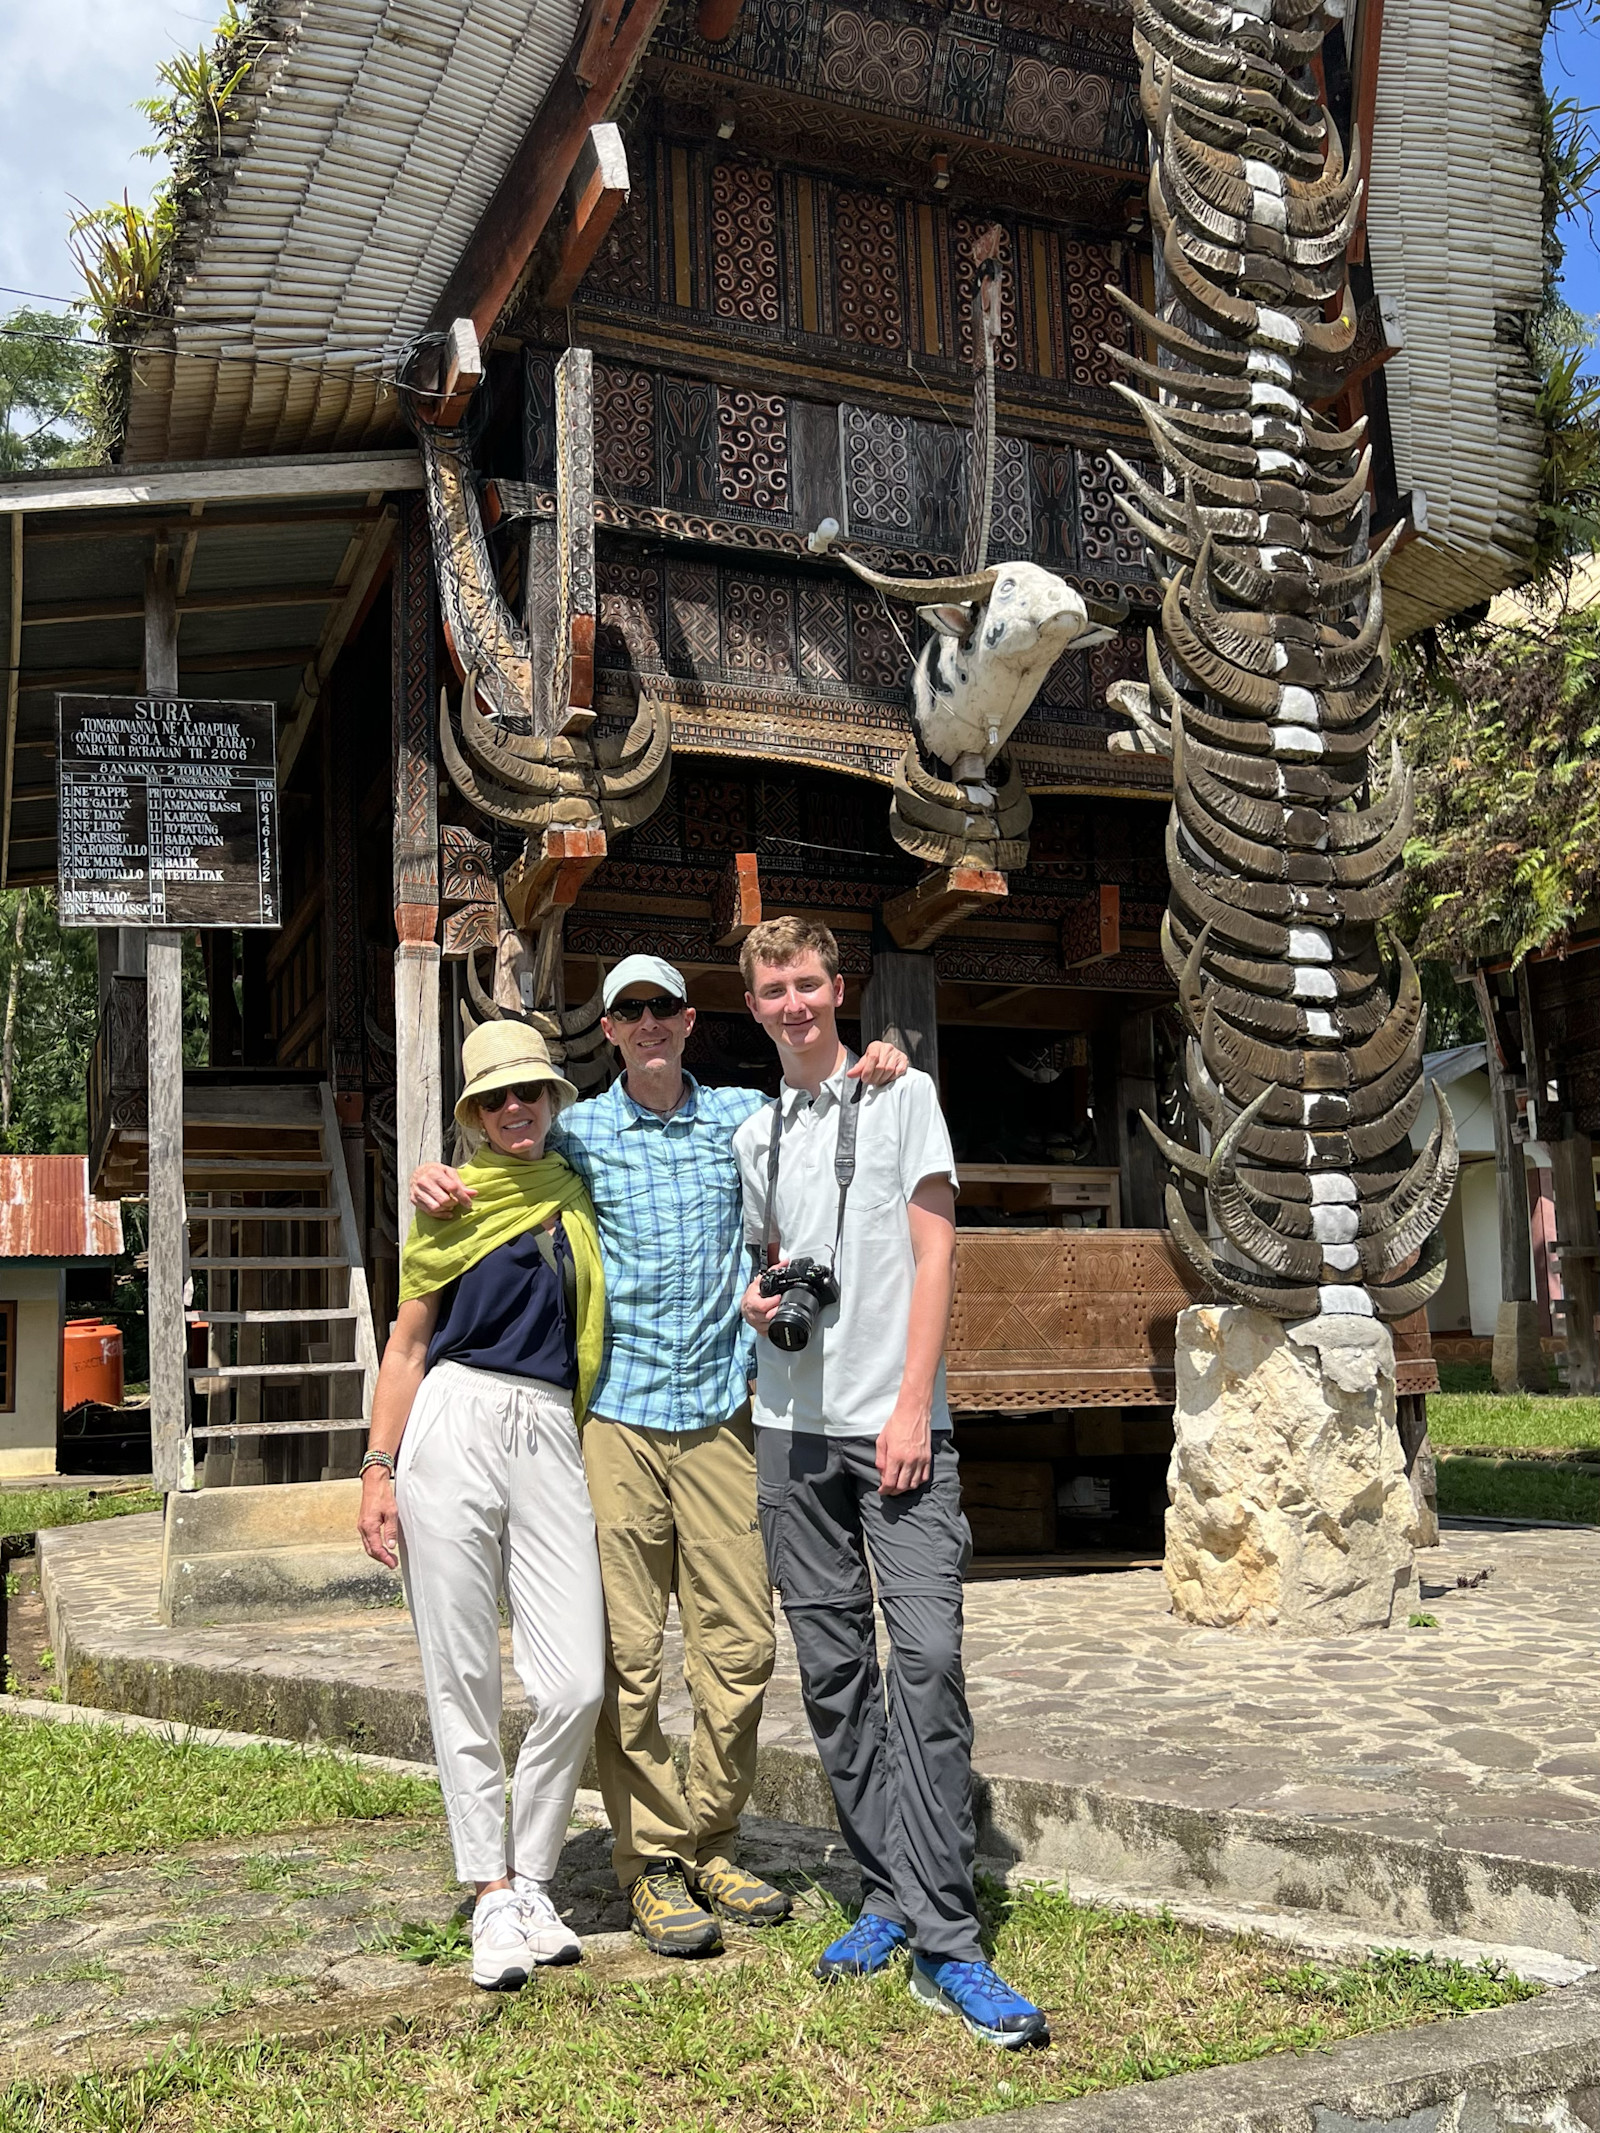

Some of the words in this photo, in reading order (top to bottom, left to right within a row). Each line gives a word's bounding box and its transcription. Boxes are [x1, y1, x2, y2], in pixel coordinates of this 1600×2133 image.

[134, 701, 193, 721] SURA'
[81, 718, 158, 734] TONGKONANNA
[184, 722, 240, 737] KARAPUAK
[71, 732, 120, 745] (ONDOAN
[129, 734, 161, 746] SOLA
[169, 735, 211, 748] SAMAN
[211, 749, 247, 761] 2006
[100, 763, 108, 773] 8
[110, 763, 157, 775] ANAKNA
[167, 765, 175, 775] 2
[177, 766, 233, 778] TODIANAK
[172, 777, 231, 786] TONGKONANNA
[260, 791, 273, 802] 10
[162, 801, 207, 811] AMPANG
[209, 802, 242, 812] BASSI
[261, 803, 269, 813] 6
[164, 812, 212, 823] KARUAYA
[261, 815, 269, 825] 4
[262, 826, 270, 836] 6
[164, 835, 223, 846] BABANGAN
[263, 838, 269, 848] 1
[262, 848, 270, 859] 4
[165, 858, 199, 868] BALIK
[262, 860, 270, 870] 2
[165, 870, 224, 881] TETELITAK
[263, 871, 270, 882] 2
[264, 894, 272, 905] 3
[264, 905, 273, 917] 4
